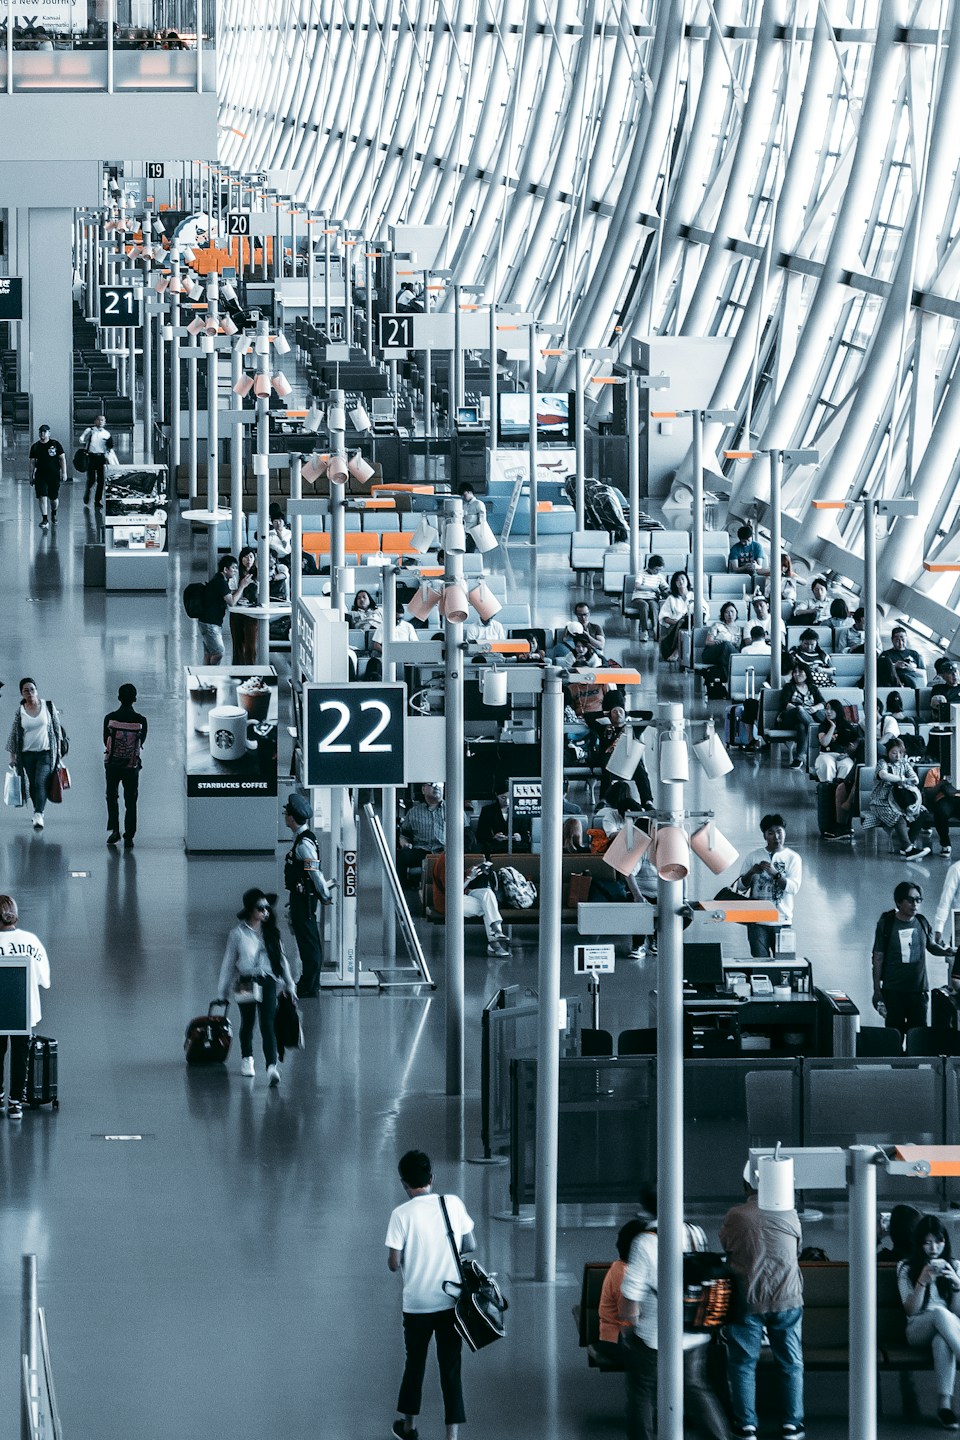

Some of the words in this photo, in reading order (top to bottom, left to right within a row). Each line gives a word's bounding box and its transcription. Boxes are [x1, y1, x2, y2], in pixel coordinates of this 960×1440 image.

[151, 164, 162, 178] 19
[231, 216, 247, 234] 20
[104, 291, 133, 314] 21
[387, 319, 409, 345] 21
[318, 701, 393, 753] 22
[346, 866, 356, 896] AED
